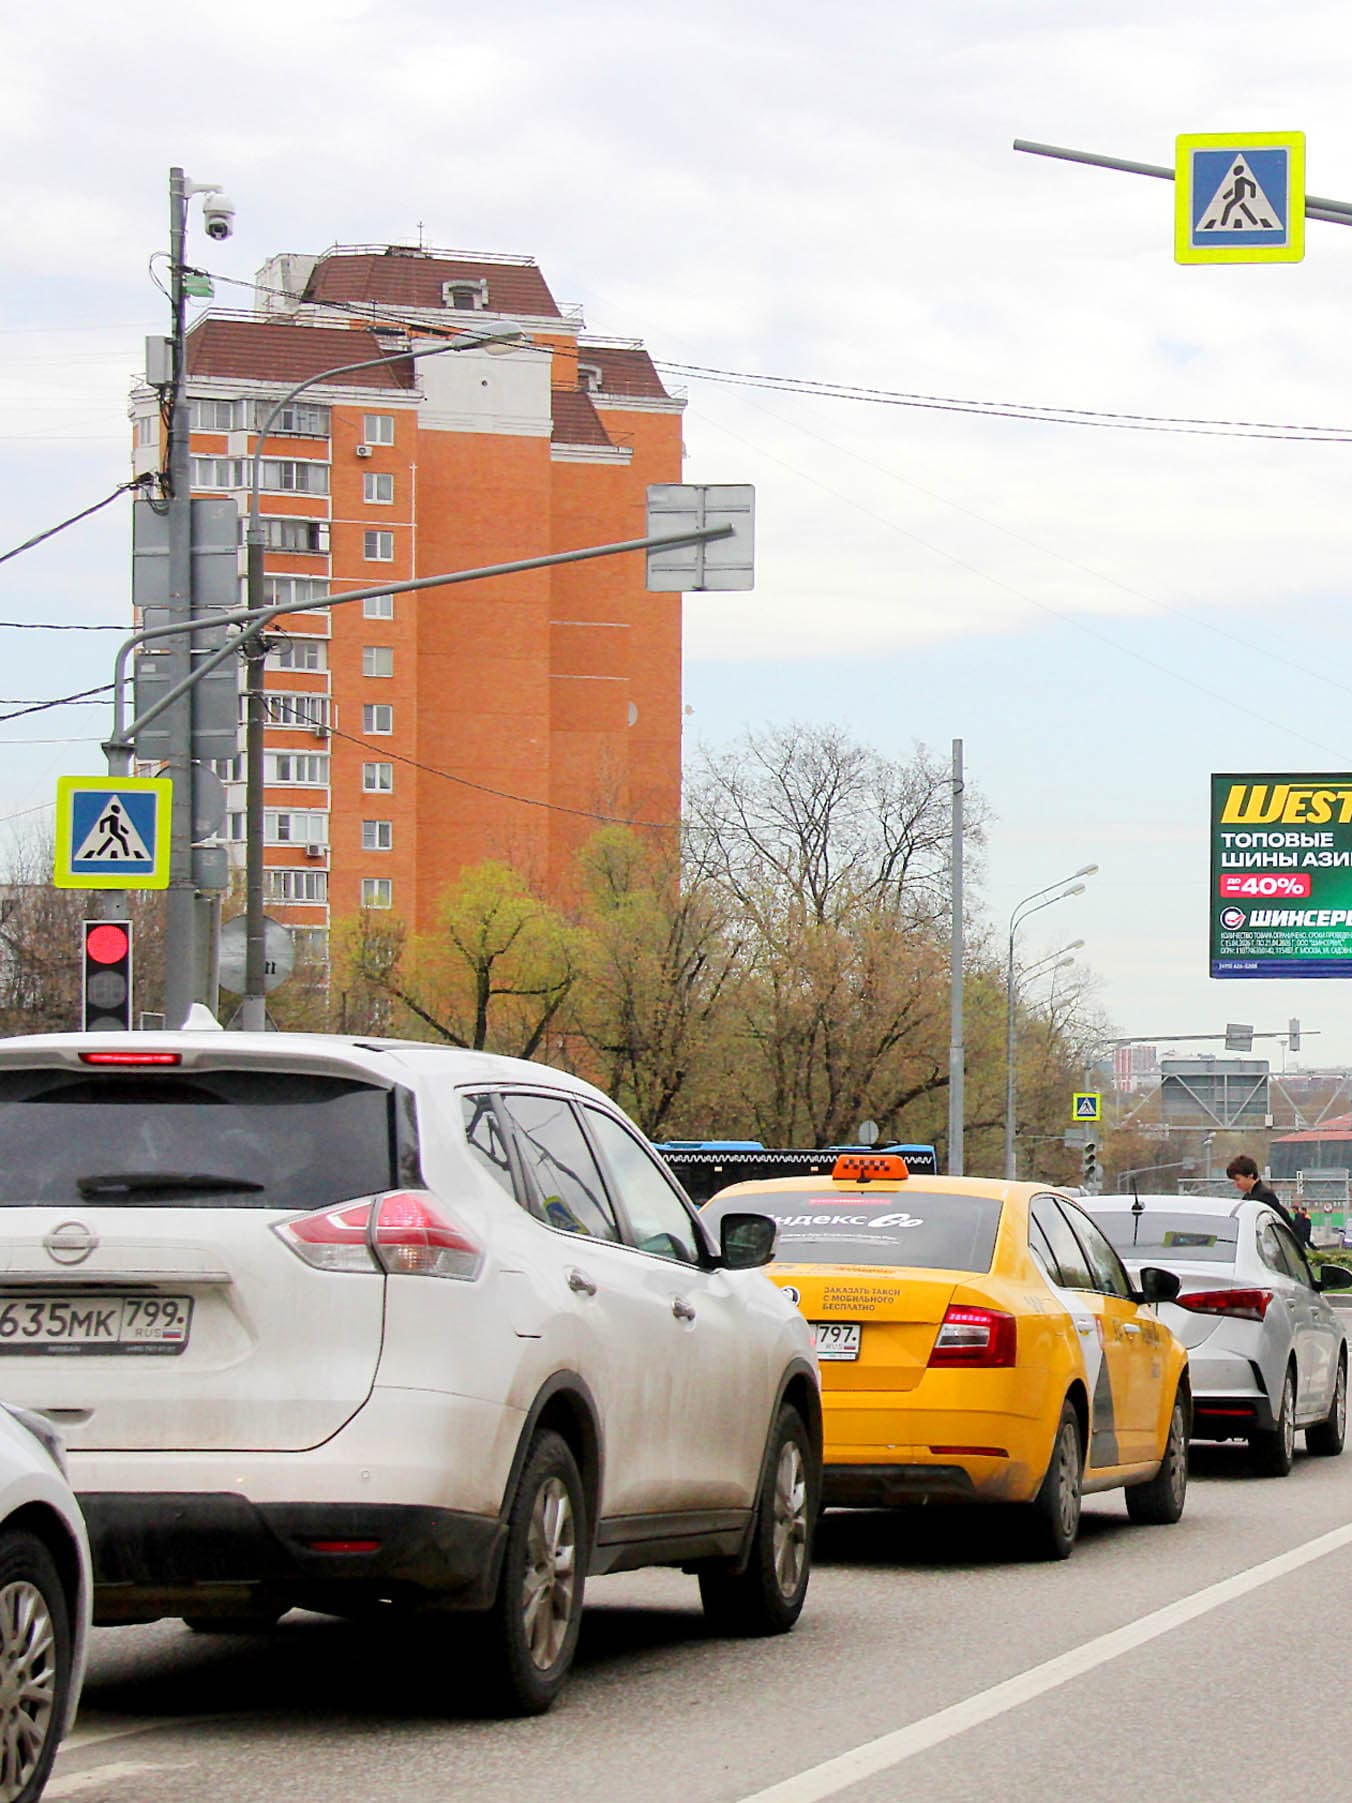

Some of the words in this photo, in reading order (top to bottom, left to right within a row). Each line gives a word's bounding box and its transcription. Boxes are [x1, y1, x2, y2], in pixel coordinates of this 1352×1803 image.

[1221, 832, 1334, 848] ТОПОВЫЕ
[1221, 852, 1298, 867] ШИНЫ
[824, 1287, 869, 1295] ЗАКАЗАТЬ
[872, 1288, 901, 1296] ТАКСИ
[831, 1295, 894, 1304] МОБИЛЬНОГО
[823, 1303, 875, 1311] БЕСПЛАТНО
[135, 1329, 161, 1337] RUS
[819, 1326, 853, 1343] 797
